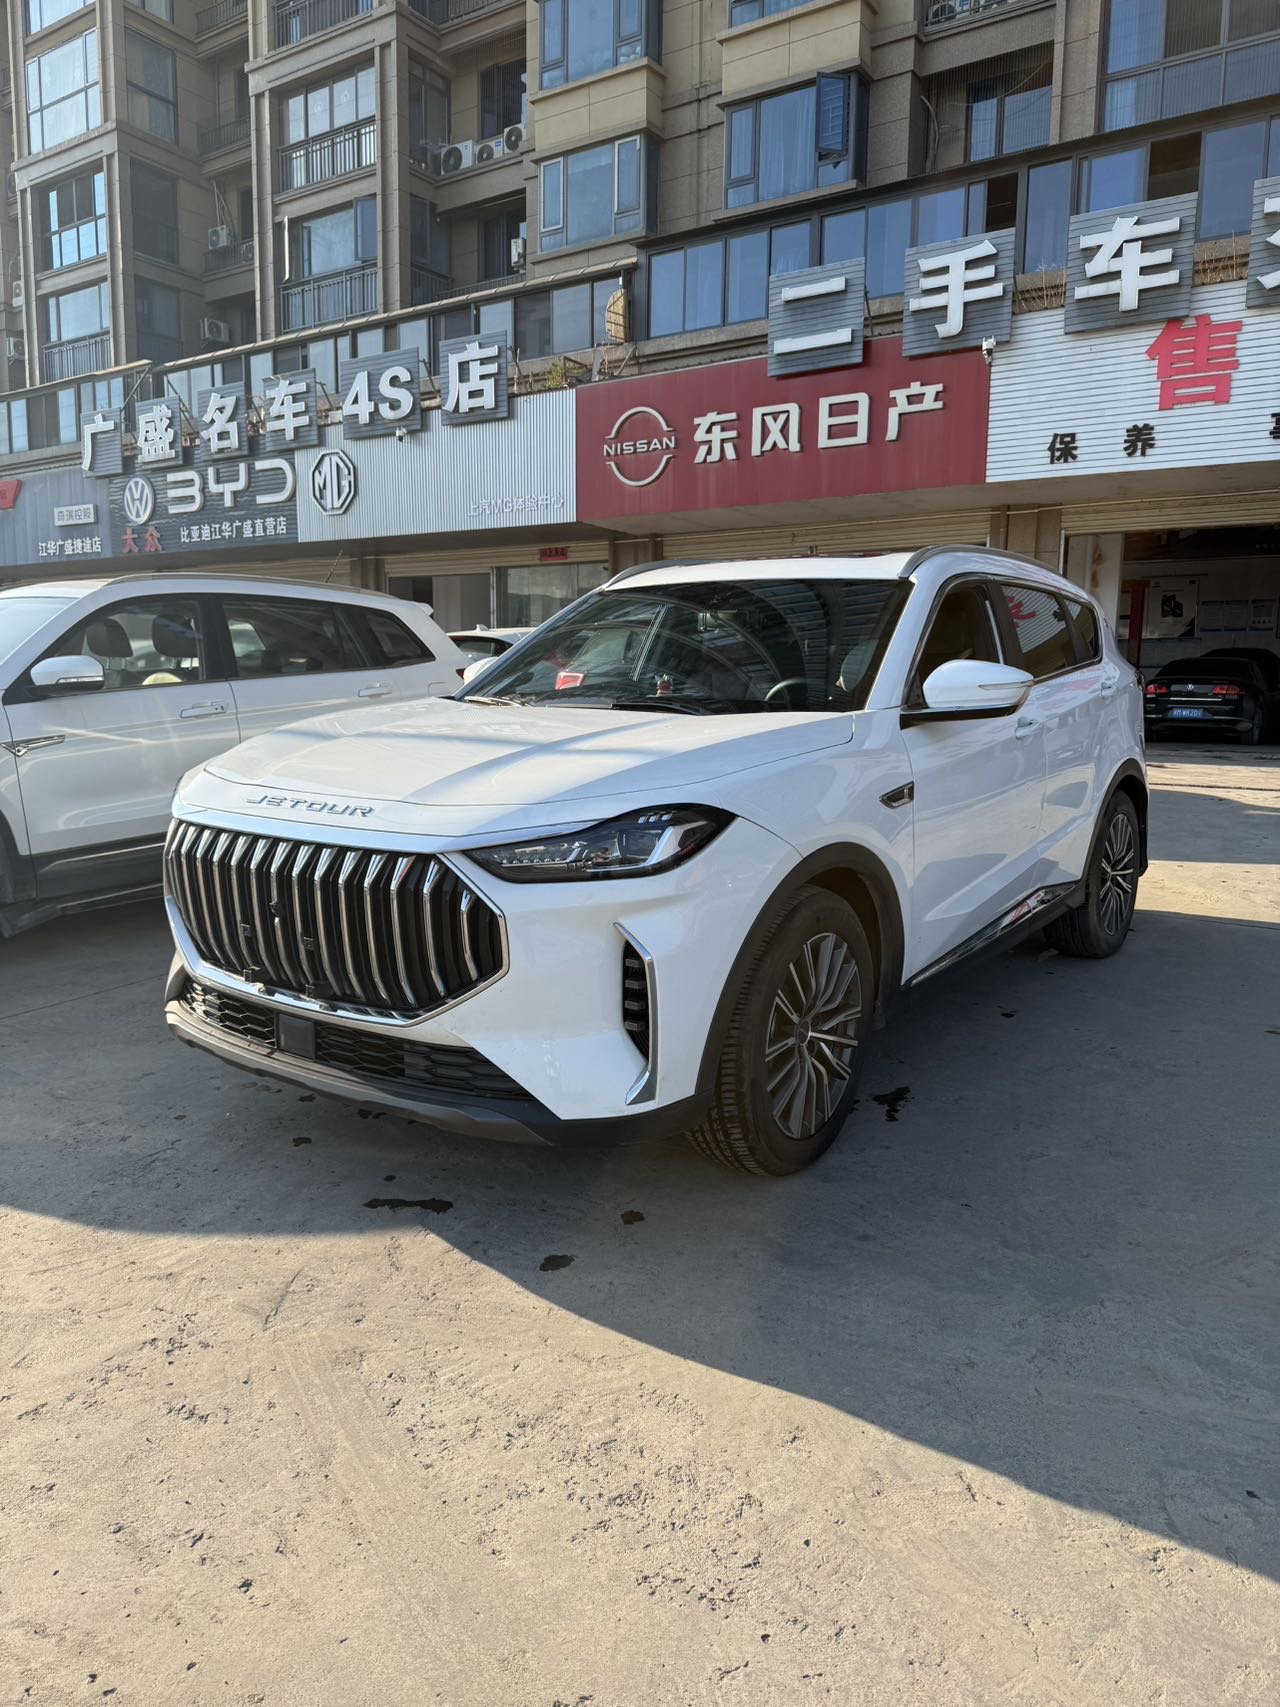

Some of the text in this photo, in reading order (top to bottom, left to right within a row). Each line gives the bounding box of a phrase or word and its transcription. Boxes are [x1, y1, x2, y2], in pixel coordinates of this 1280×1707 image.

[1145, 313, 1243, 411] 售
[81, 341, 499, 471] 广盛名车4S店
[692, 381, 945, 465] 东风日产
[603, 435, 676, 457] NISSAN
[166, 458, 295, 515] BYD
[313, 451, 352, 511] MG
[38, 536, 102, 556] 江华广盛捷途店
[121, 527, 162, 554] 大众
[180, 516, 287, 543] 比亚迪江华广盛直营店
[246, 795, 375, 818] JETOUR
